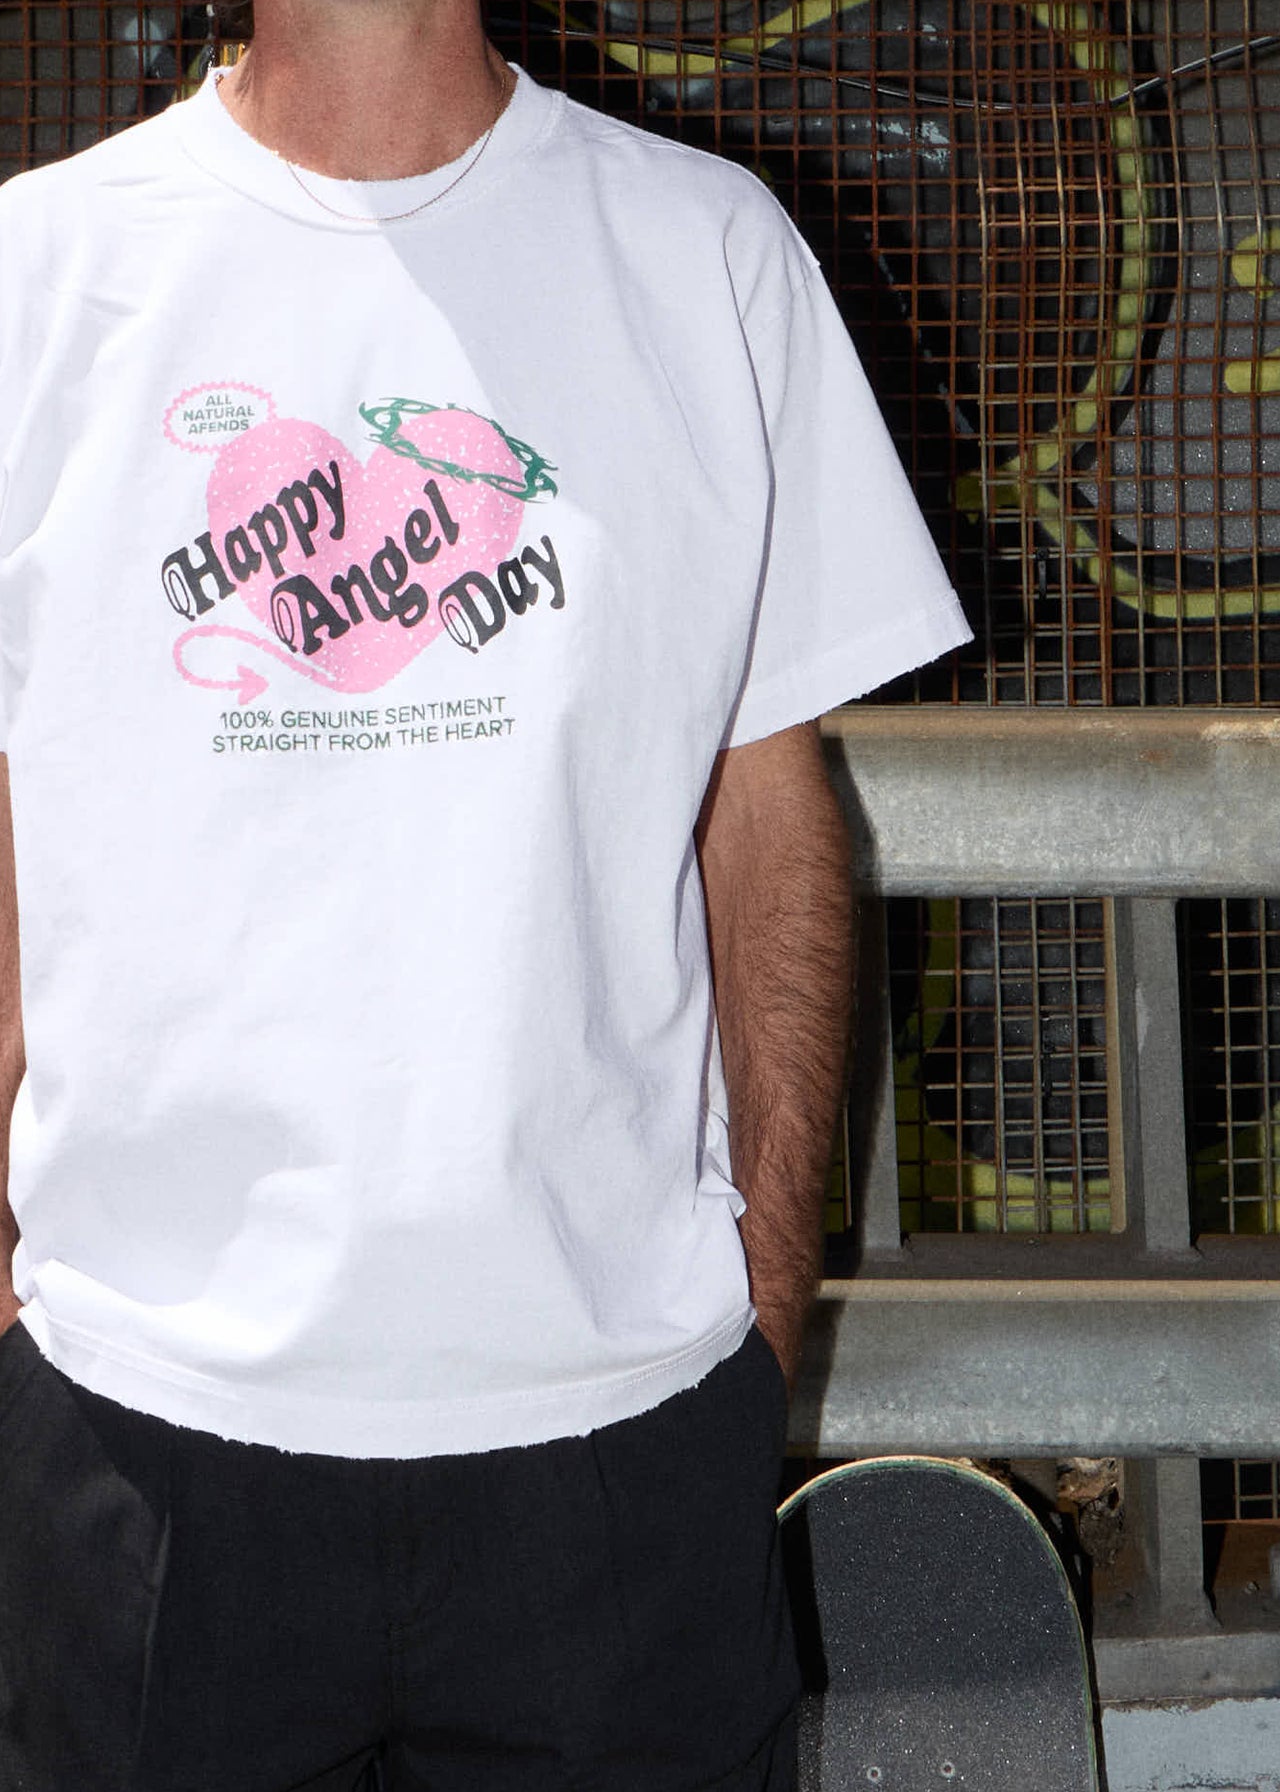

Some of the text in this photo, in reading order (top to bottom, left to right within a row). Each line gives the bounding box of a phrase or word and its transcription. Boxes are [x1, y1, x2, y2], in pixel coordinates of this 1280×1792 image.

[182, 405, 256, 422] NATURAL
[205, 395, 232, 407] ALL
[187, 419, 250, 435] AFENDS
[161, 460, 345, 621] Happy
[270, 479, 460, 656] Angel
[438, 535, 566, 654] Day
[219, 696, 507, 730] 100% GENUINE SENTIMENT
[212, 718, 516, 753] STRAIGHT FROM THE HEART
